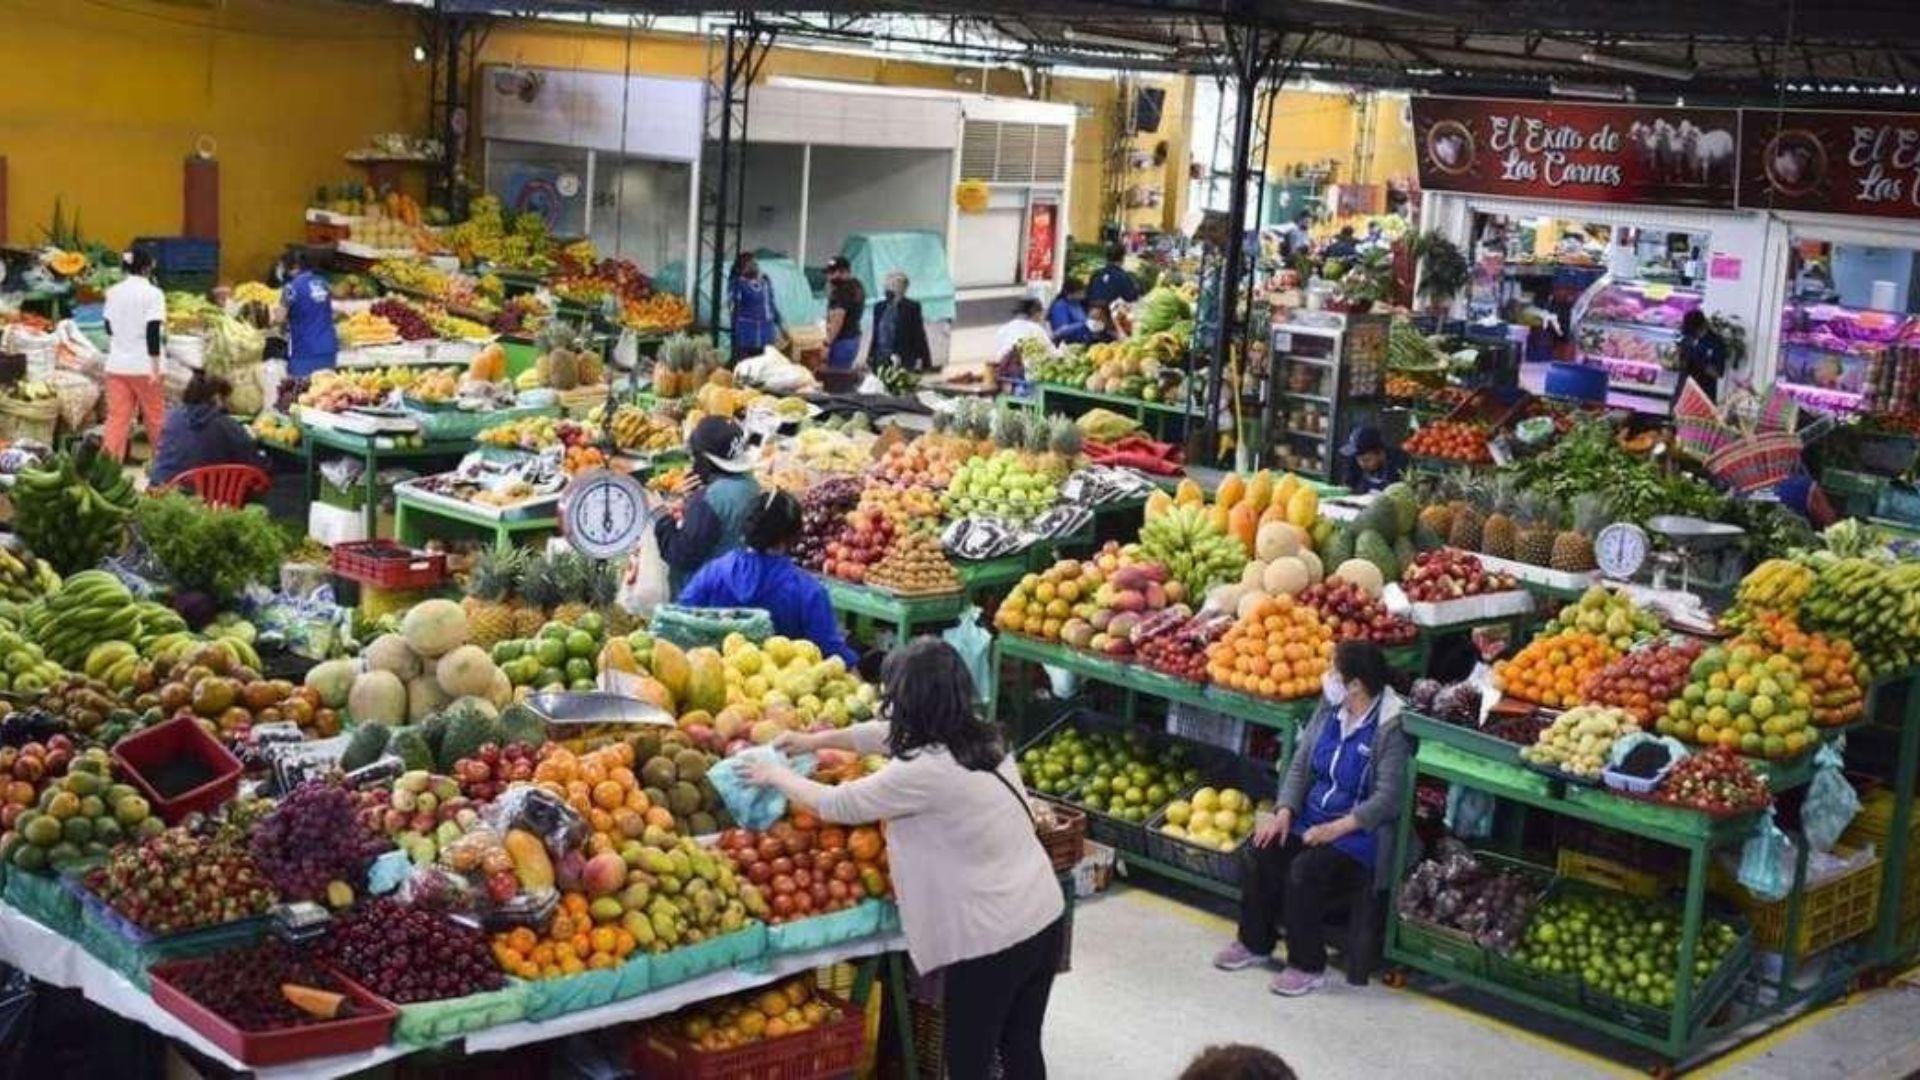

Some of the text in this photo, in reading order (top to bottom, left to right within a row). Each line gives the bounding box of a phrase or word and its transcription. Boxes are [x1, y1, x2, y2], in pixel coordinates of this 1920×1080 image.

[1489, 114, 1620, 153] El Exito de
[1849, 125, 1920, 169] El E
[1501, 148, 1622, 187] Las Carnes
[1856, 163, 1903, 201] Las
